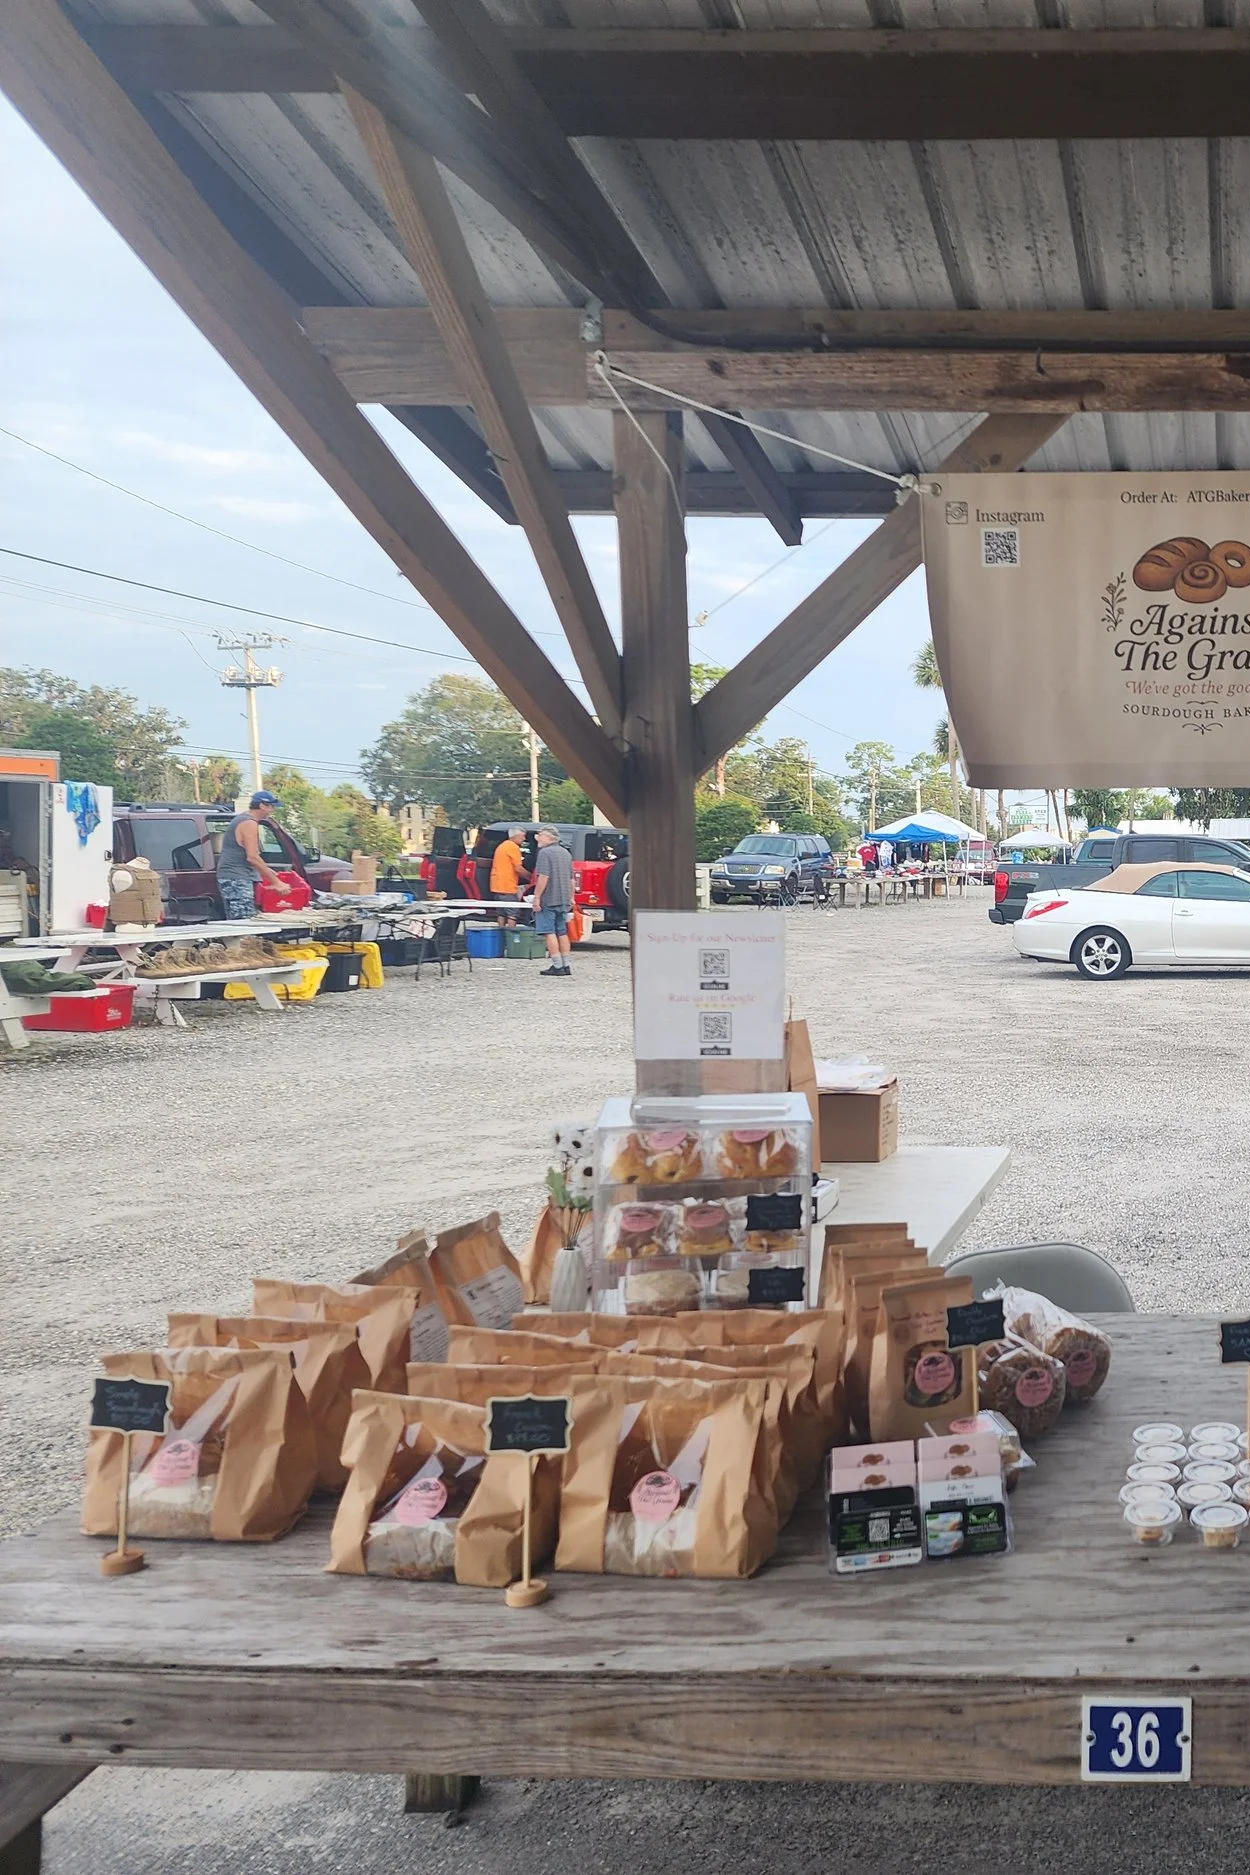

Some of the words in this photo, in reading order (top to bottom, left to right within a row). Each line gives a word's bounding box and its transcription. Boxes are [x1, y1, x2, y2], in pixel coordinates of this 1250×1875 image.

[1120, 491, 1158, 503] Order
[1160, 491, 1178, 503] At:
[976, 509, 1045, 526] Instagram
[1114, 639, 1178, 671] The
[1126, 680, 1170, 695] We've
[1172, 683, 1199, 698] got
[1201, 681, 1224, 694] the
[1122, 703, 1214, 719] SOURDOUGH
[1110, 1711, 1160, 1768] 36
